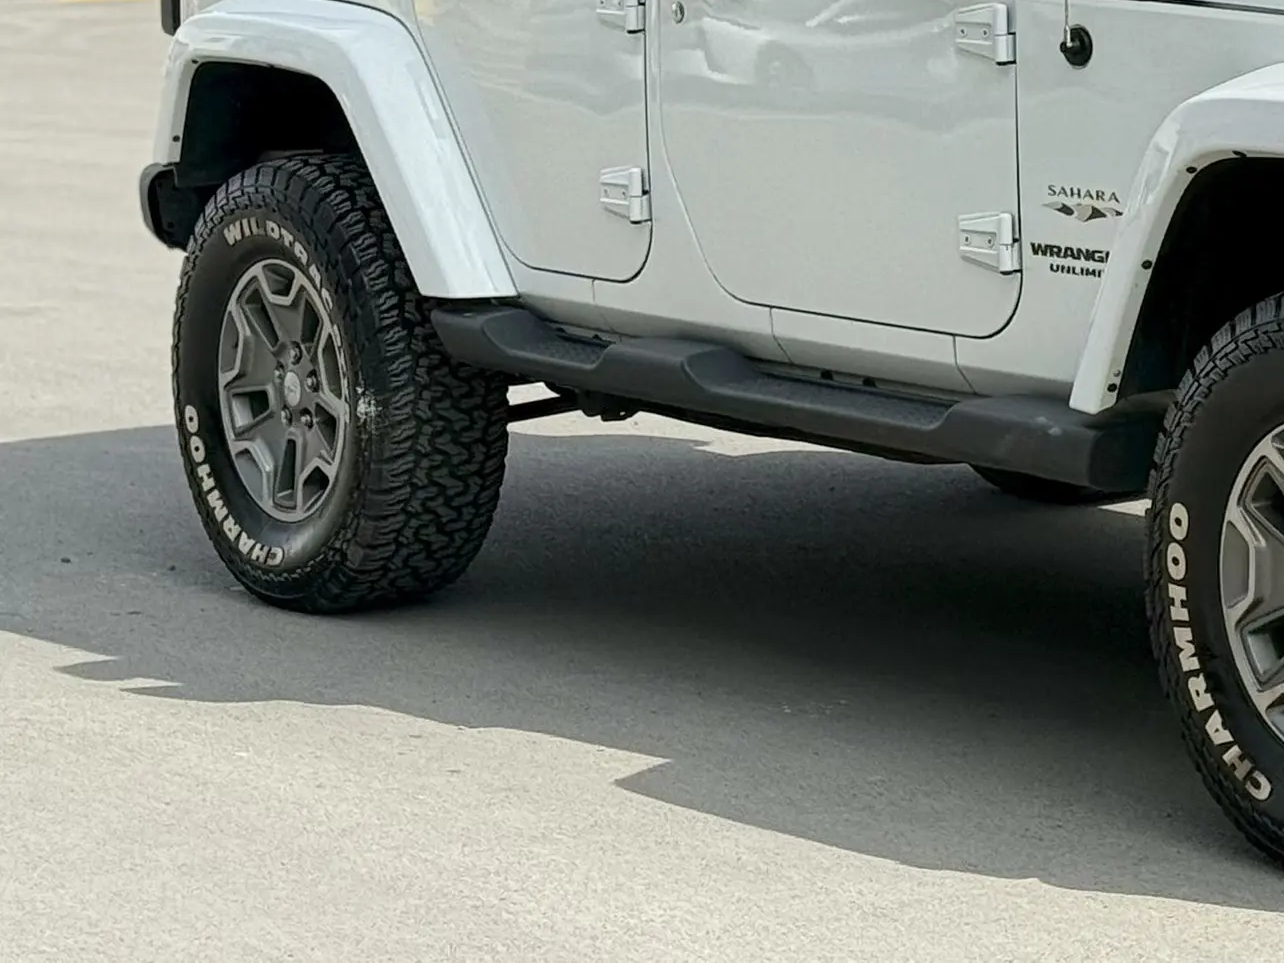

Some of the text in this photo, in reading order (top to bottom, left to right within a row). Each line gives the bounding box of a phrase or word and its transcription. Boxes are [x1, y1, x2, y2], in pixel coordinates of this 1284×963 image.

[1047, 184, 1120, 204] SAHARA
[184, 404, 284, 566] CHARMHOO
[1166, 502, 1272, 802] CHARMHOO
